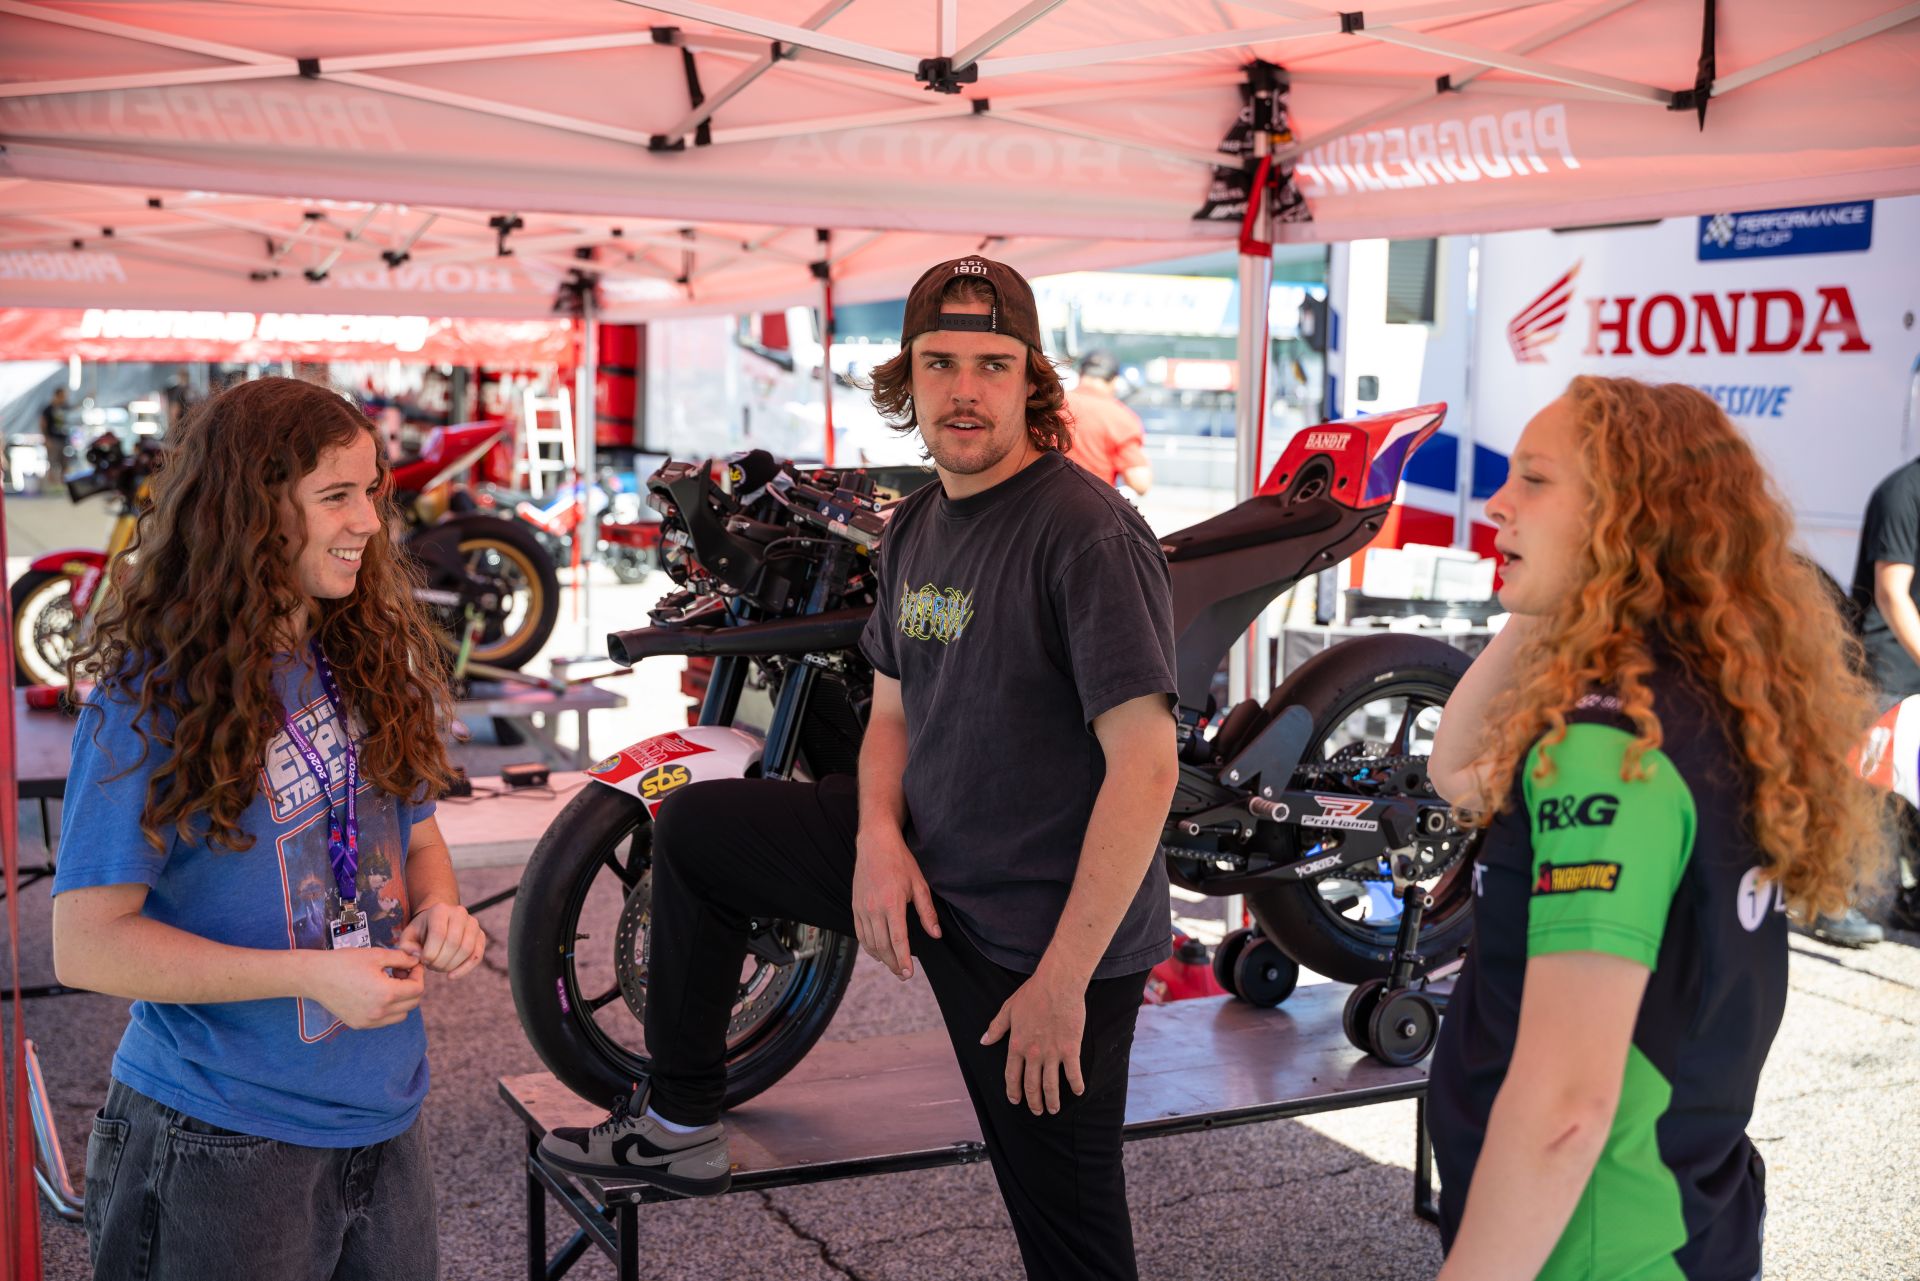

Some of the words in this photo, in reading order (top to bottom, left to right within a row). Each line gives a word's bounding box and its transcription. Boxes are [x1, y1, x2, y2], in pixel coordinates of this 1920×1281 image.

[1736, 205, 1867, 232] PERFORMANCE
[1734, 230, 1793, 250] SHOP
[953, 265, 988, 275] 1901
[1583, 286, 1872, 357] HONDA
[1303, 431, 1352, 451] BANDIT
[306, 752, 328, 779] 2026
[348, 755, 356, 786] 2026
[642, 765, 689, 798] sbs
[1538, 793, 1620, 833] R&G
[1295, 853, 1343, 878] VORTEX
